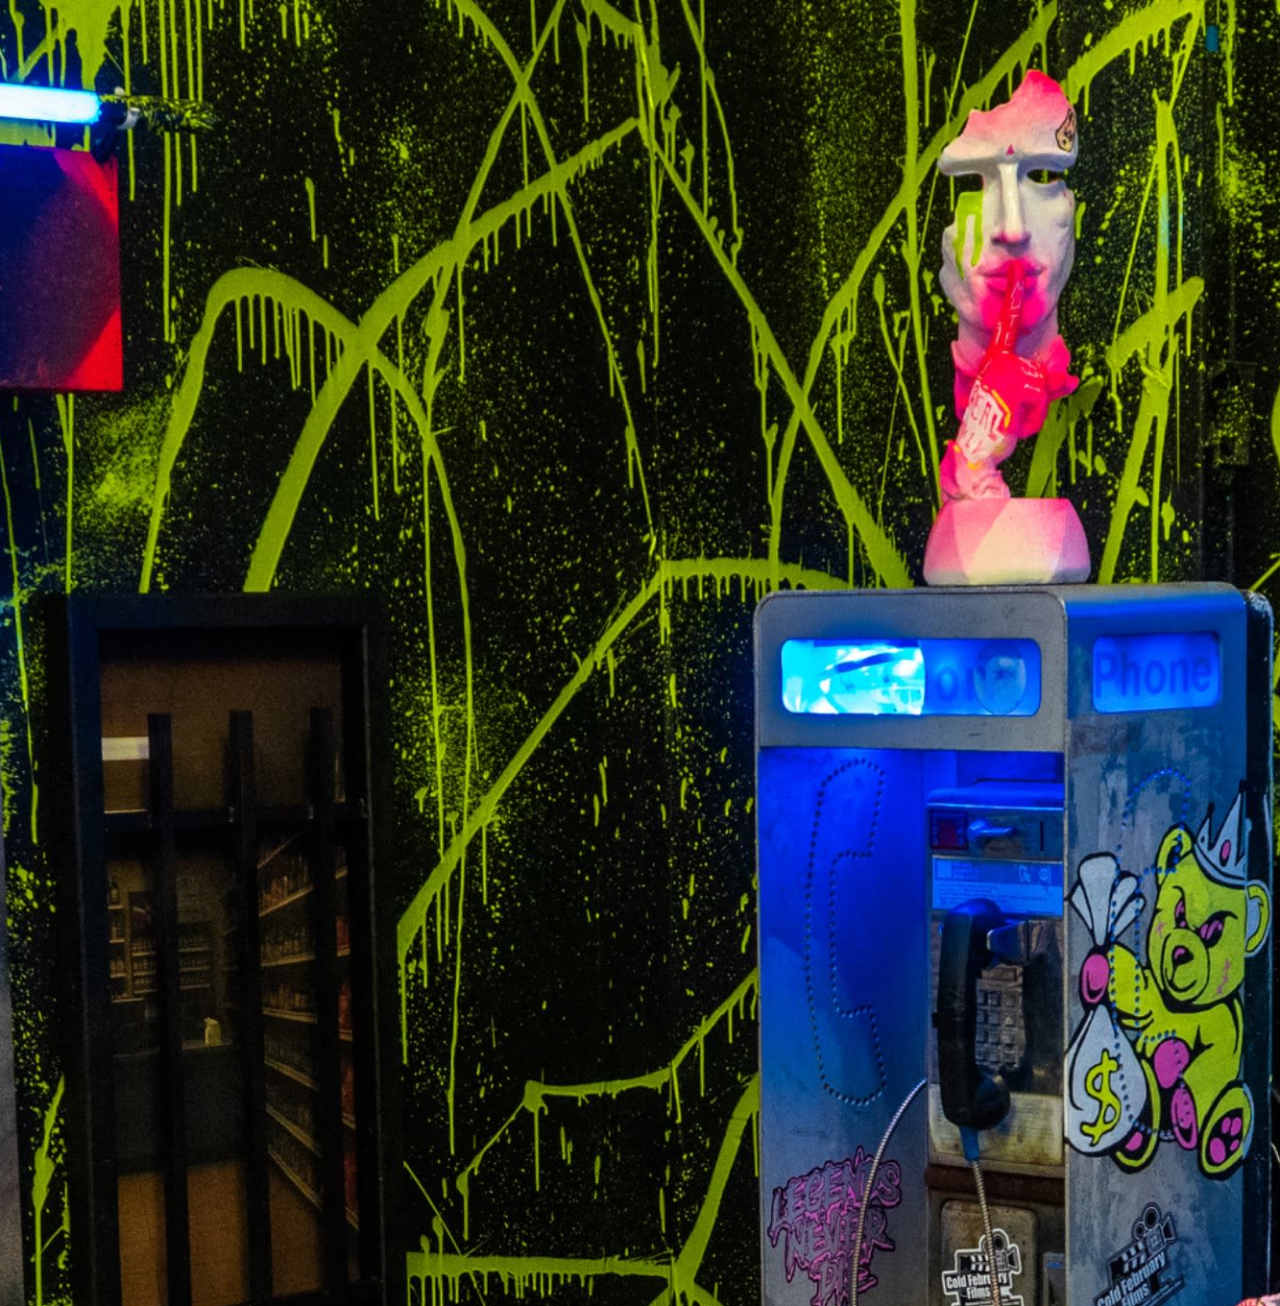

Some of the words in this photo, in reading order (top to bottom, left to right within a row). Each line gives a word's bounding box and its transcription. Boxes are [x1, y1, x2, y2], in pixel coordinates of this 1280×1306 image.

[1094, 651, 1213, 702] Phone
[786, 1205, 896, 1275] NEVER
[946, 1274, 967, 1290] Cold
[967, 1272, 1008, 1287] Februry
[1120, 1252, 1167, 1296] February
